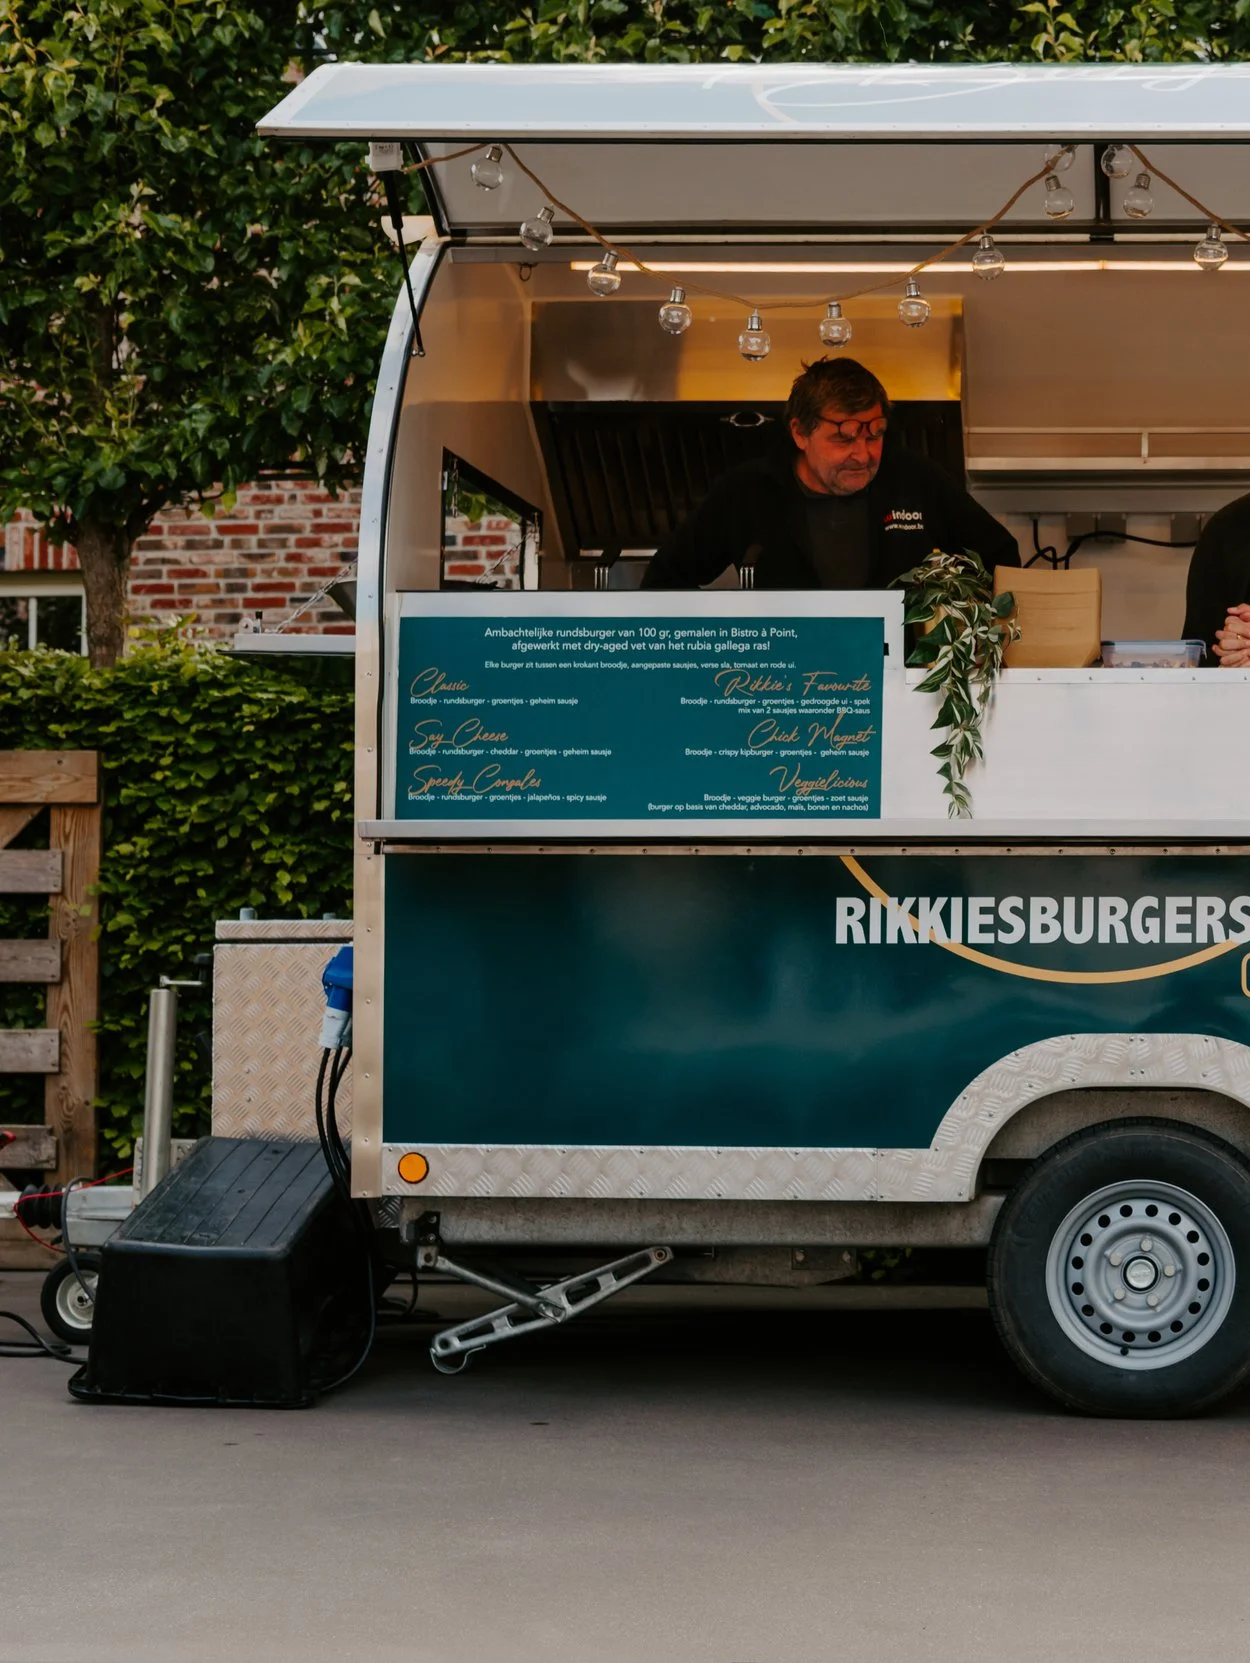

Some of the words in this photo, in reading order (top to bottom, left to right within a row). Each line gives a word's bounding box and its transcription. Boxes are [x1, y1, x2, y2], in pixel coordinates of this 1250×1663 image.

[484, 627, 554, 640] Ambachtelijke
[555, 627, 616, 640] rundsburger
[638, 627, 657, 637] 100
[658, 630, 672, 640] gr,
[673, 628, 717, 640] gemalen
[718, 628, 728, 637] in
[730, 627, 759, 638] Bistro
[760, 628, 768, 637] à
[769, 627, 798, 638] Point,
[511, 640, 560, 653] afgewerkt
[561, 642, 582, 650] met
[582, 640, 629, 653] dry-aged
[630, 642, 646, 650] vet
[667, 640, 685, 650] het
[686, 640, 712, 650] rubia
[713, 640, 751, 653] gallega
[752, 641, 770, 651] ras!
[500, 662, 524, 670] burger
[630, 662, 672, 670] aangepaste
[410, 667, 470, 697] Classic
[714, 668, 793, 697] Rikkie's
[802, 671, 872, 696] Favourite
[410, 697, 438, 706] Broodje
[443, 697, 485, 706] rundsburger
[491, 698, 524, 706] groentjes
[529, 697, 556, 706] geheim
[680, 697, 708, 706] Broodje
[713, 697, 756, 706] rundsburger
[761, 698, 795, 706] groentjes
[800, 698, 840, 707] gedroogde
[853, 698, 870, 706] spek
[737, 706, 751, 714] mix
[765, 706, 771, 714] 2
[772, 707, 798, 716] sausjes
[798, 706, 836, 714] waaronder
[836, 706, 871, 715] BBQ-saus
[409, 718, 449, 749] Say
[452, 718, 509, 748] Cheese
[748, 718, 801, 748] Chick
[808, 711, 876, 750] Magnet
[408, 747, 437, 756] Broodje
[442, 747, 484, 757] rundsburger
[524, 749, 557, 757] groentjes
[562, 748, 589, 757] geheim
[590, 749, 612, 757] sausje
[684, 748, 713, 757] Broodje
[739, 748, 774, 757] kipburger
[779, 749, 812, 757] groentjes
[820, 747, 847, 758] geheim
[847, 750, 870, 758] sausje
[408, 764, 468, 795] Speedy
[769, 762, 869, 795] Veggielicious
[407, 793, 435, 802] Broodje
[440, 792, 483, 802] rundsburger
[488, 794, 522, 802] groentjes
[527, 793, 560, 802] jalapeños
[703, 793, 732, 803] Broodje
[737, 795, 762, 803] veggie
[762, 794, 786, 803] burger
[791, 793, 825, 803] groentjes
[647, 803, 673, 812] (burger
[718, 803, 748, 811] cheddar,
[749, 803, 786, 811] advocado,
[806, 803, 830, 811] bonen
[841, 803, 869, 811] nachos)
